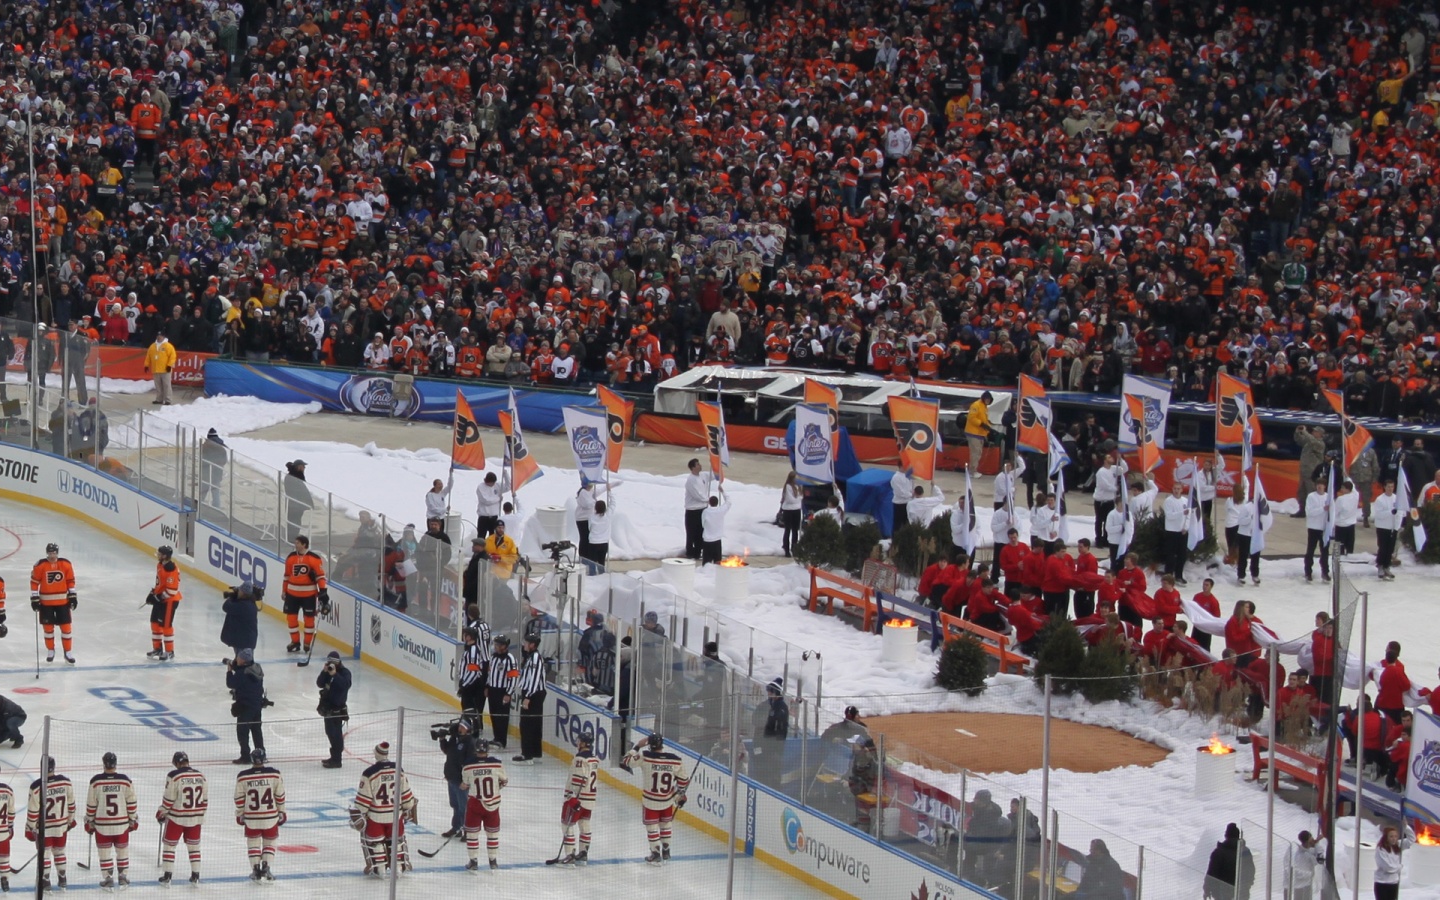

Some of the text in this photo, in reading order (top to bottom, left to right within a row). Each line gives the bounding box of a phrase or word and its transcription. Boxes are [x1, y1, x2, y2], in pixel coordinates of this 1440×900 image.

[72, 475, 119, 514] HONDA
[208, 534, 268, 592] GEICO
[86, 686, 220, 742] GEICO
[474, 777, 494, 799] 10
[652, 772, 673, 794] 19
[45, 796, 66, 819] 27
[105, 794, 119, 816] 5
[182, 785, 203, 809] 32
[247, 787, 274, 811] 34
[786, 817, 871, 884] Compuware
